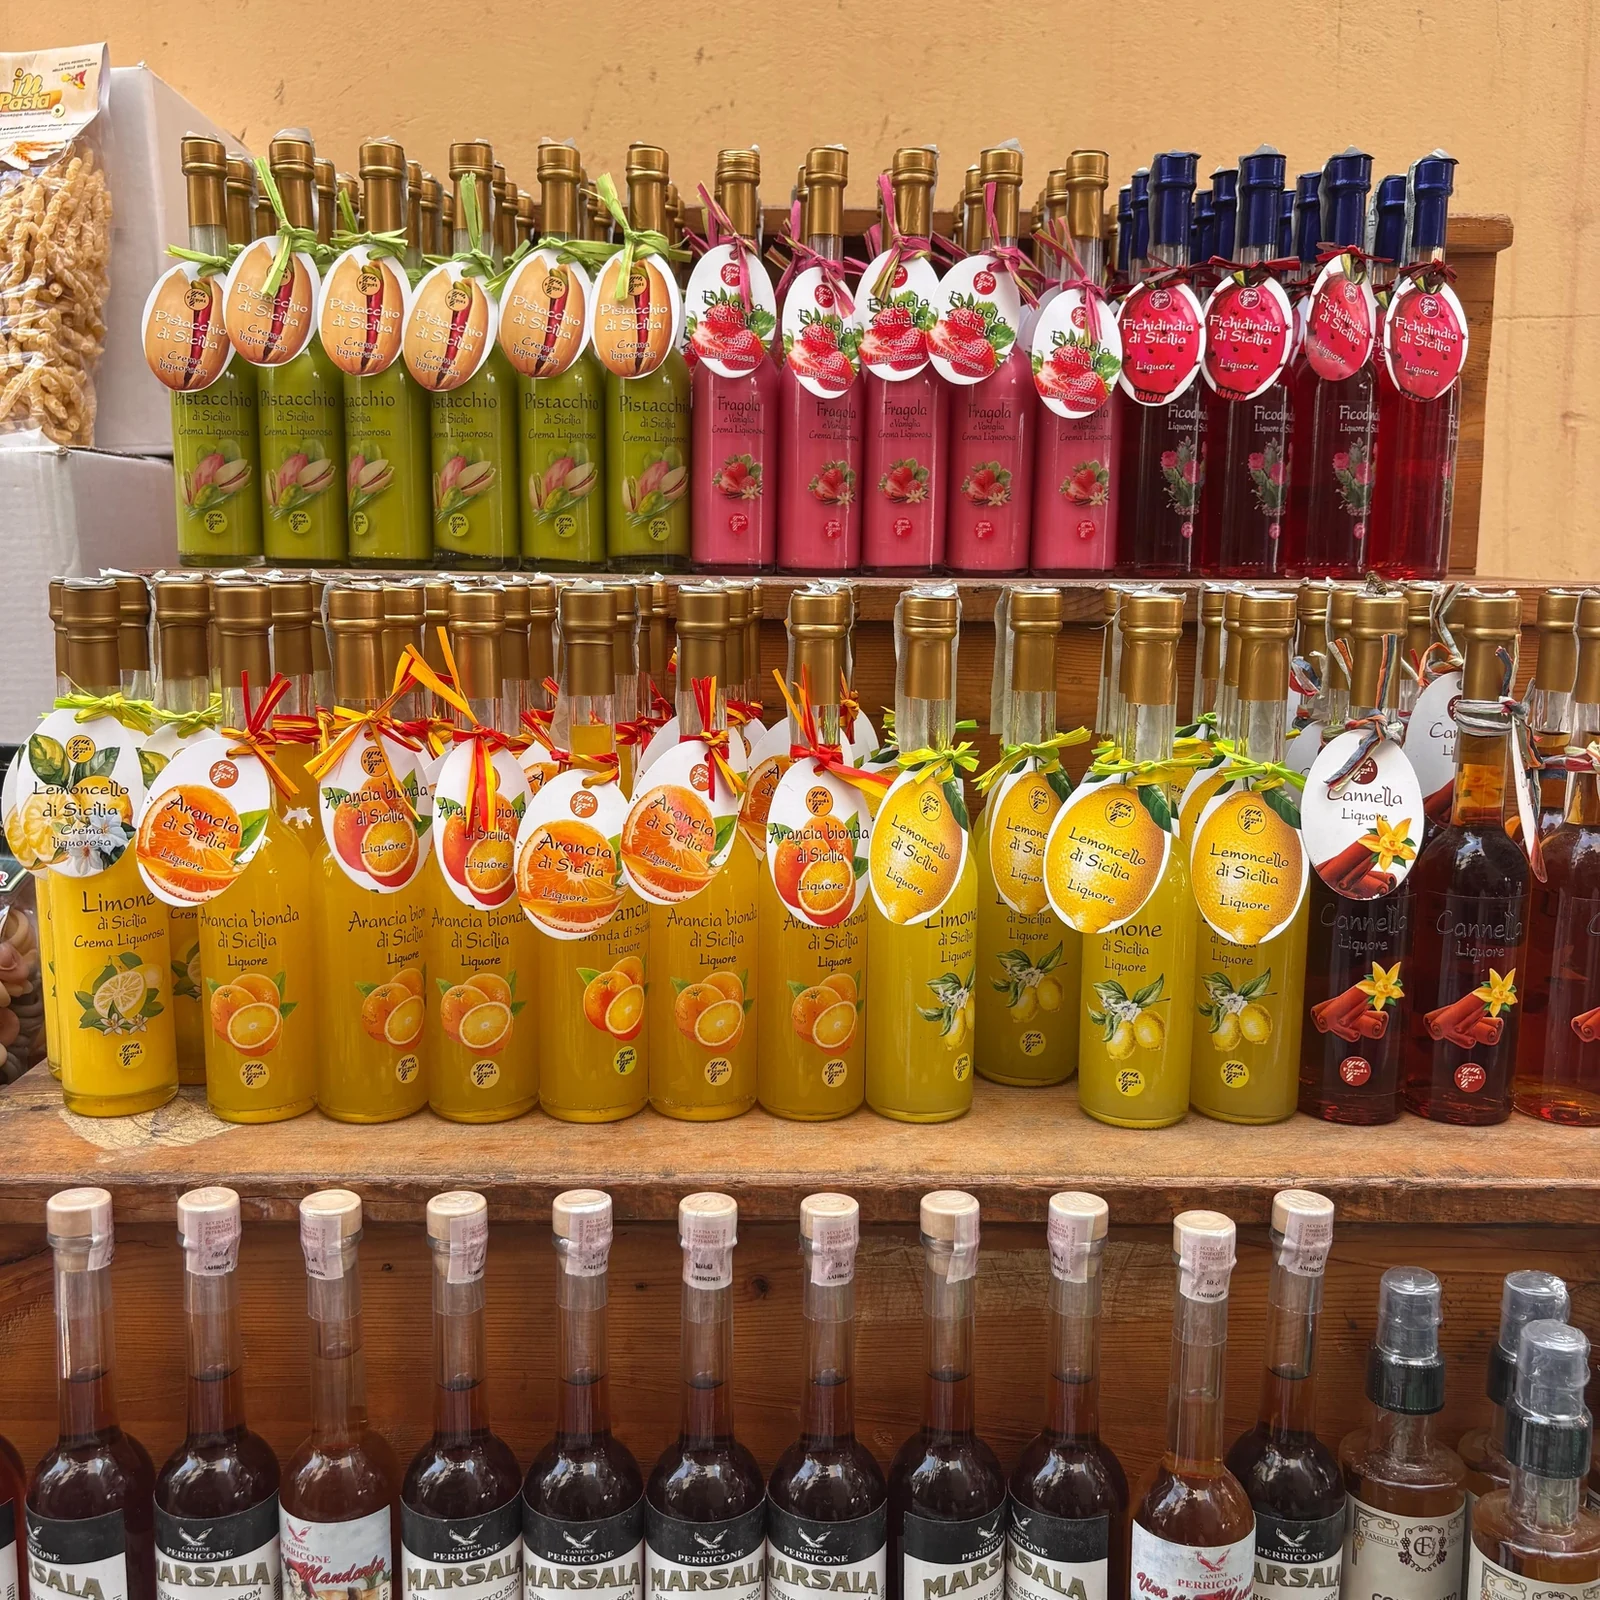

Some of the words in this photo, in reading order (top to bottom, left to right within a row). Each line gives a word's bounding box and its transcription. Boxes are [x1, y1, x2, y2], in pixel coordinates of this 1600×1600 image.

[0, 91, 51, 112] Pasta
[330, 297, 400, 319] Pistacchio
[512, 295, 581, 327] Pistacchio
[600, 302, 668, 315] Pistacchio
[867, 295, 930, 313] Fragola
[948, 291, 1006, 325] Fragola
[155, 310, 227, 335] Pistacchio
[255, 304, 299, 327] Sicilia
[348, 316, 393, 333] Sicilia
[416, 308, 483, 337] Pistacchio
[620, 318, 662, 331] Sicilia
[1123, 318, 1194, 332] Fichidindia
[1209, 315, 1281, 333] Fichidindia
[1319, 293, 1367, 338] Fichidindia
[248, 324, 283, 341] Crema
[529, 317, 571, 340] Sicilia
[1215, 328, 1227, 341] di
[1230, 330, 1272, 346] Sicilia
[1320, 313, 1329, 323] di
[1331, 319, 1360, 346] Sicilia
[1395, 317, 1458, 341] Fichidindia
[174, 328, 218, 349] Sicilia
[343, 336, 379, 349] Crema
[431, 330, 473, 351] Sicilia
[521, 337, 555, 354] Crema
[617, 339, 650, 349] Crema
[1050, 330, 1110, 355] Fragola
[1129, 333, 1140, 344] di
[1144, 332, 1186, 345] Sicilia
[1400, 333, 1411, 344] di
[1414, 335, 1451, 352] Sicilia
[167, 351, 202, 365] Crema
[423, 350, 456, 366] Crema
[1316, 341, 1346, 365] Liquore
[1136, 361, 1175, 373] Liquore
[1220, 359, 1259, 371] Liquore
[1405, 362, 1439, 376] Liquore
[525, 393, 599, 410] Pistacchio
[717, 396, 761, 417] Fragola
[884, 399, 927, 421] Fragola
[816, 401, 856, 424] Fragola
[969, 403, 1011, 423] Fragola
[206, 425, 250, 439] Liquorosa
[290, 425, 333, 439] Liquorosa
[558, 428, 597, 443] Liquorosa
[962, 433, 982, 441] Crema
[1168, 422, 1194, 433] Liquore
[1255, 423, 1279, 434] Liquore
[1340, 423, 1364, 434] Liquore
[33, 781, 129, 797] Lemoncello
[325, 787, 381, 809] Arancia
[1327, 786, 1403, 807] Cannella
[43, 803, 57, 817] di
[63, 802, 118, 818] Sicilia
[166, 795, 239, 834] Arancia
[356, 810, 367, 826] di
[370, 809, 405, 825] Sicilia
[650, 794, 714, 838] Arancia
[61, 825, 104, 835] Crema
[163, 816, 177, 831] di
[180, 823, 226, 850] Sicilia
[646, 815, 659, 830] di
[662, 823, 703, 852] Sicilia
[769, 823, 823, 844] Arancia
[826, 821, 870, 840] bionda
[891, 814, 950, 861] Lemoncello
[52, 837, 111, 850] liquorosa
[361, 842, 407, 857] Liquore
[538, 833, 612, 859] Arancia
[1069, 827, 1146, 866] Lemoncello
[160, 848, 204, 872] Liquore
[641, 846, 682, 873] Liquore
[797, 849, 807, 863] di
[810, 848, 844, 864] Sicilia
[891, 835, 902, 851] di
[903, 845, 939, 874] Sicilia
[1070, 847, 1082, 862] di
[1085, 853, 1130, 881] Sicilia
[1210, 843, 1289, 868] Lemoncello
[465, 857, 509, 873] Liquore
[538, 855, 552, 870] di
[556, 858, 604, 878] Sicilia
[1216, 862, 1229, 877] di
[1233, 866, 1278, 885] Sicilia
[798, 880, 844, 895] Liquore
[886, 866, 924, 896] Liquore
[81, 890, 156, 913] Limone
[542, 887, 589, 903] Liquore
[1067, 879, 1116, 905] Liquore
[1220, 894, 1270, 912] Liquore
[97, 917, 108, 930] di
[112, 915, 147, 929] Sicilia
[200, 907, 248, 928] Arancia
[251, 904, 299, 927] bionda
[348, 910, 407, 932] Arancia
[431, 908, 483, 929] Arancia
[666, 907, 722, 928] Arancia
[1320, 902, 1408, 935] Cannella
[1436, 909, 1523, 941] Cannella
[74, 934, 113, 948] Crema
[117, 928, 165, 949] Liquorosa
[218, 931, 229, 948] di
[231, 931, 277, 950] Sicilia
[377, 931, 389, 948] di
[393, 926, 424, 947] Sicilia
[451, 931, 463, 948] di
[465, 931, 510, 949] Sicilia
[690, 932, 702, 948] di
[706, 930, 744, 948] Sicilia
[808, 934, 820, 950] di
[823, 932, 858, 950] Sicilia
[938, 932, 948, 946] di
[950, 928, 974, 944] Sicilia
[1008, 927, 1049, 946] Liquore
[1338, 934, 1388, 957] Liquore
[1102, 939, 1112, 953] di
[1113, 940, 1149, 957] Sicilia
[1455, 940, 1505, 964] Liquore
[227, 954, 268, 972] Liquore
[387, 950, 420, 967] Liquore
[461, 954, 501, 971] Liquore
[699, 953, 737, 970] Liquore
[817, 955, 852, 972] Liquore
[941, 949, 972, 967] Liquore
[1103, 955, 1147, 976] Liquore
[1212, 948, 1254, 968] Liquore
[166, 1546, 233, 1561] PERRICONE
[288, 1540, 310, 1551] CANTINE
[433, 1541, 501, 1561] PERRICONE
[783, 1545, 849, 1563] PERRICONE
[1257, 1546, 1325, 1562] PERRICONE
[547, 1550, 614, 1563] PERRICONE
[677, 1548, 744, 1564] PERRICONE
[299, 1555, 386, 1584] Mandorla
[407, 1550, 522, 1592] MARSALA
[525, 1561, 640, 1590] MARSALA
[650, 1559, 764, 1592] MARSALA
[768, 1555, 878, 1595] MARSALA
[1177, 1572, 1244, 1589] PERRICONE
